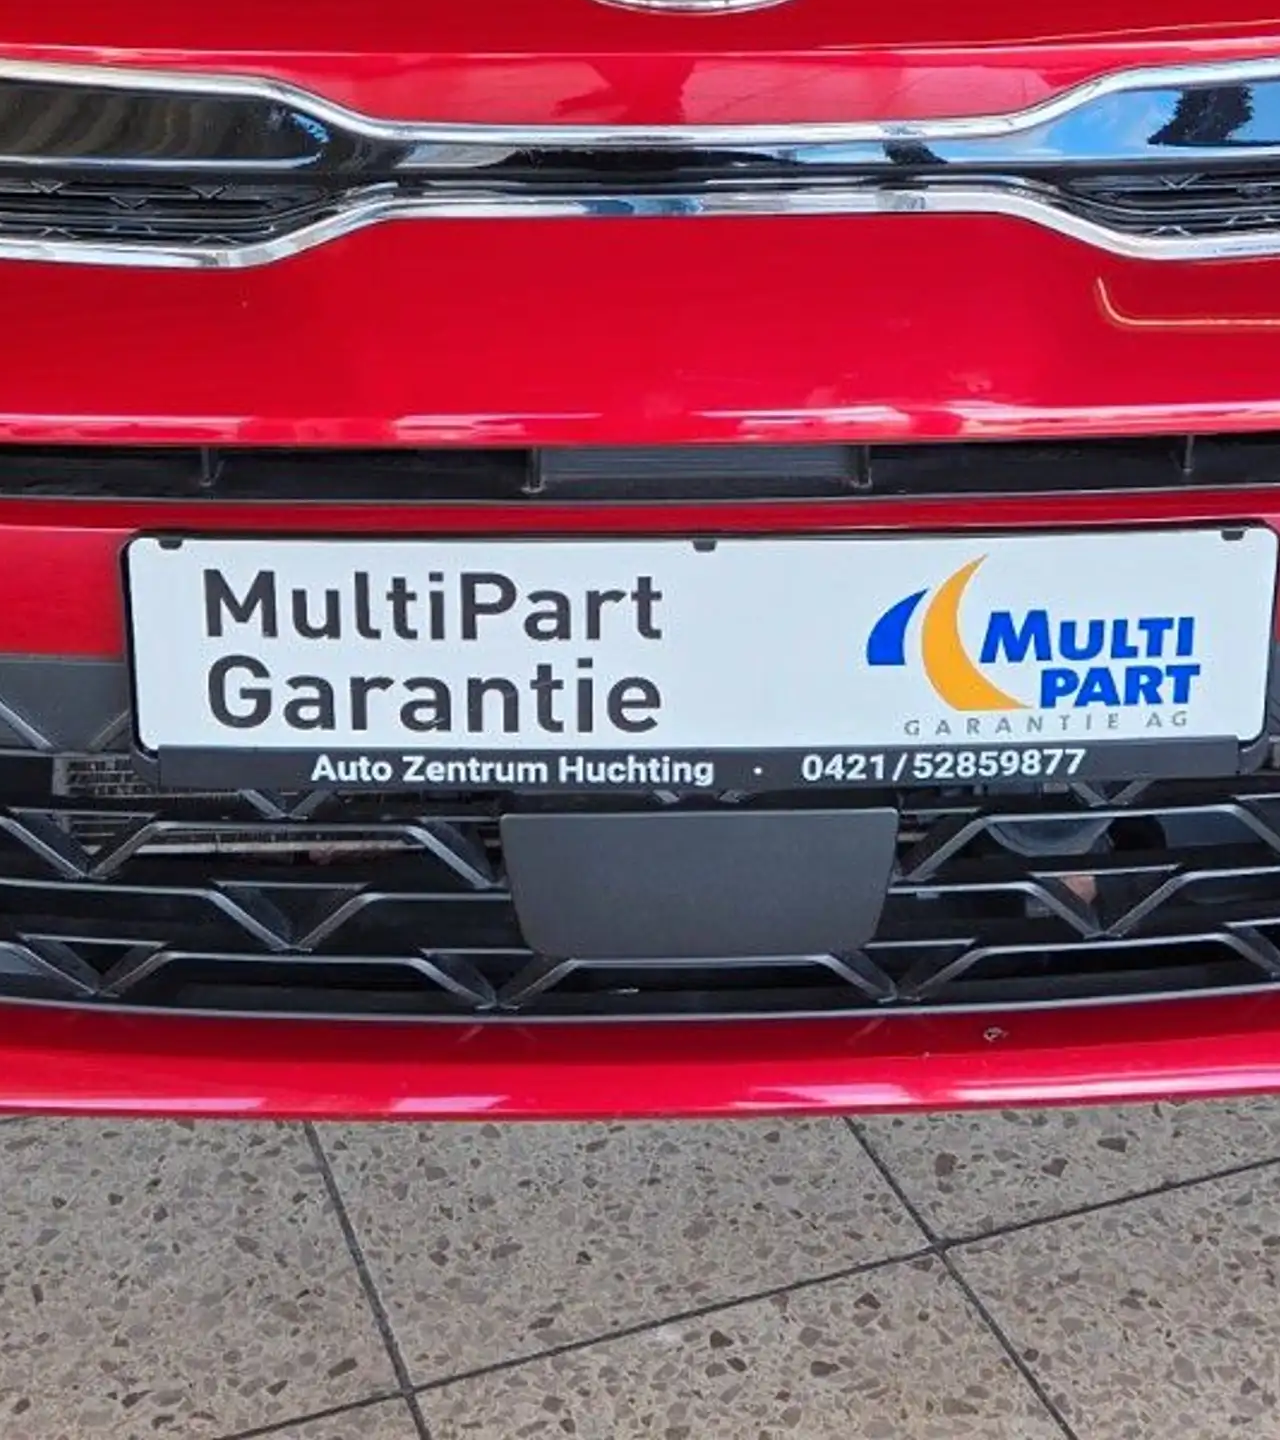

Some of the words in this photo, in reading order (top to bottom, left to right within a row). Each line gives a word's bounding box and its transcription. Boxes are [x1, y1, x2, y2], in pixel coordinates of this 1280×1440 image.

[203, 568, 663, 641] MultiPart
[979, 609, 1196, 663] MULTI
[207, 654, 661, 733] Garantie
[1039, 665, 1201, 709] PART
[904, 713, 1120, 737] GARANTIE
[1146, 710, 1189, 729] AG
[311, 755, 393, 783] Auto
[402, 755, 548, 784] Zentrum
[558, 755, 715, 789] Huchting
[801, 748, 1086, 782] 0421/52859877
